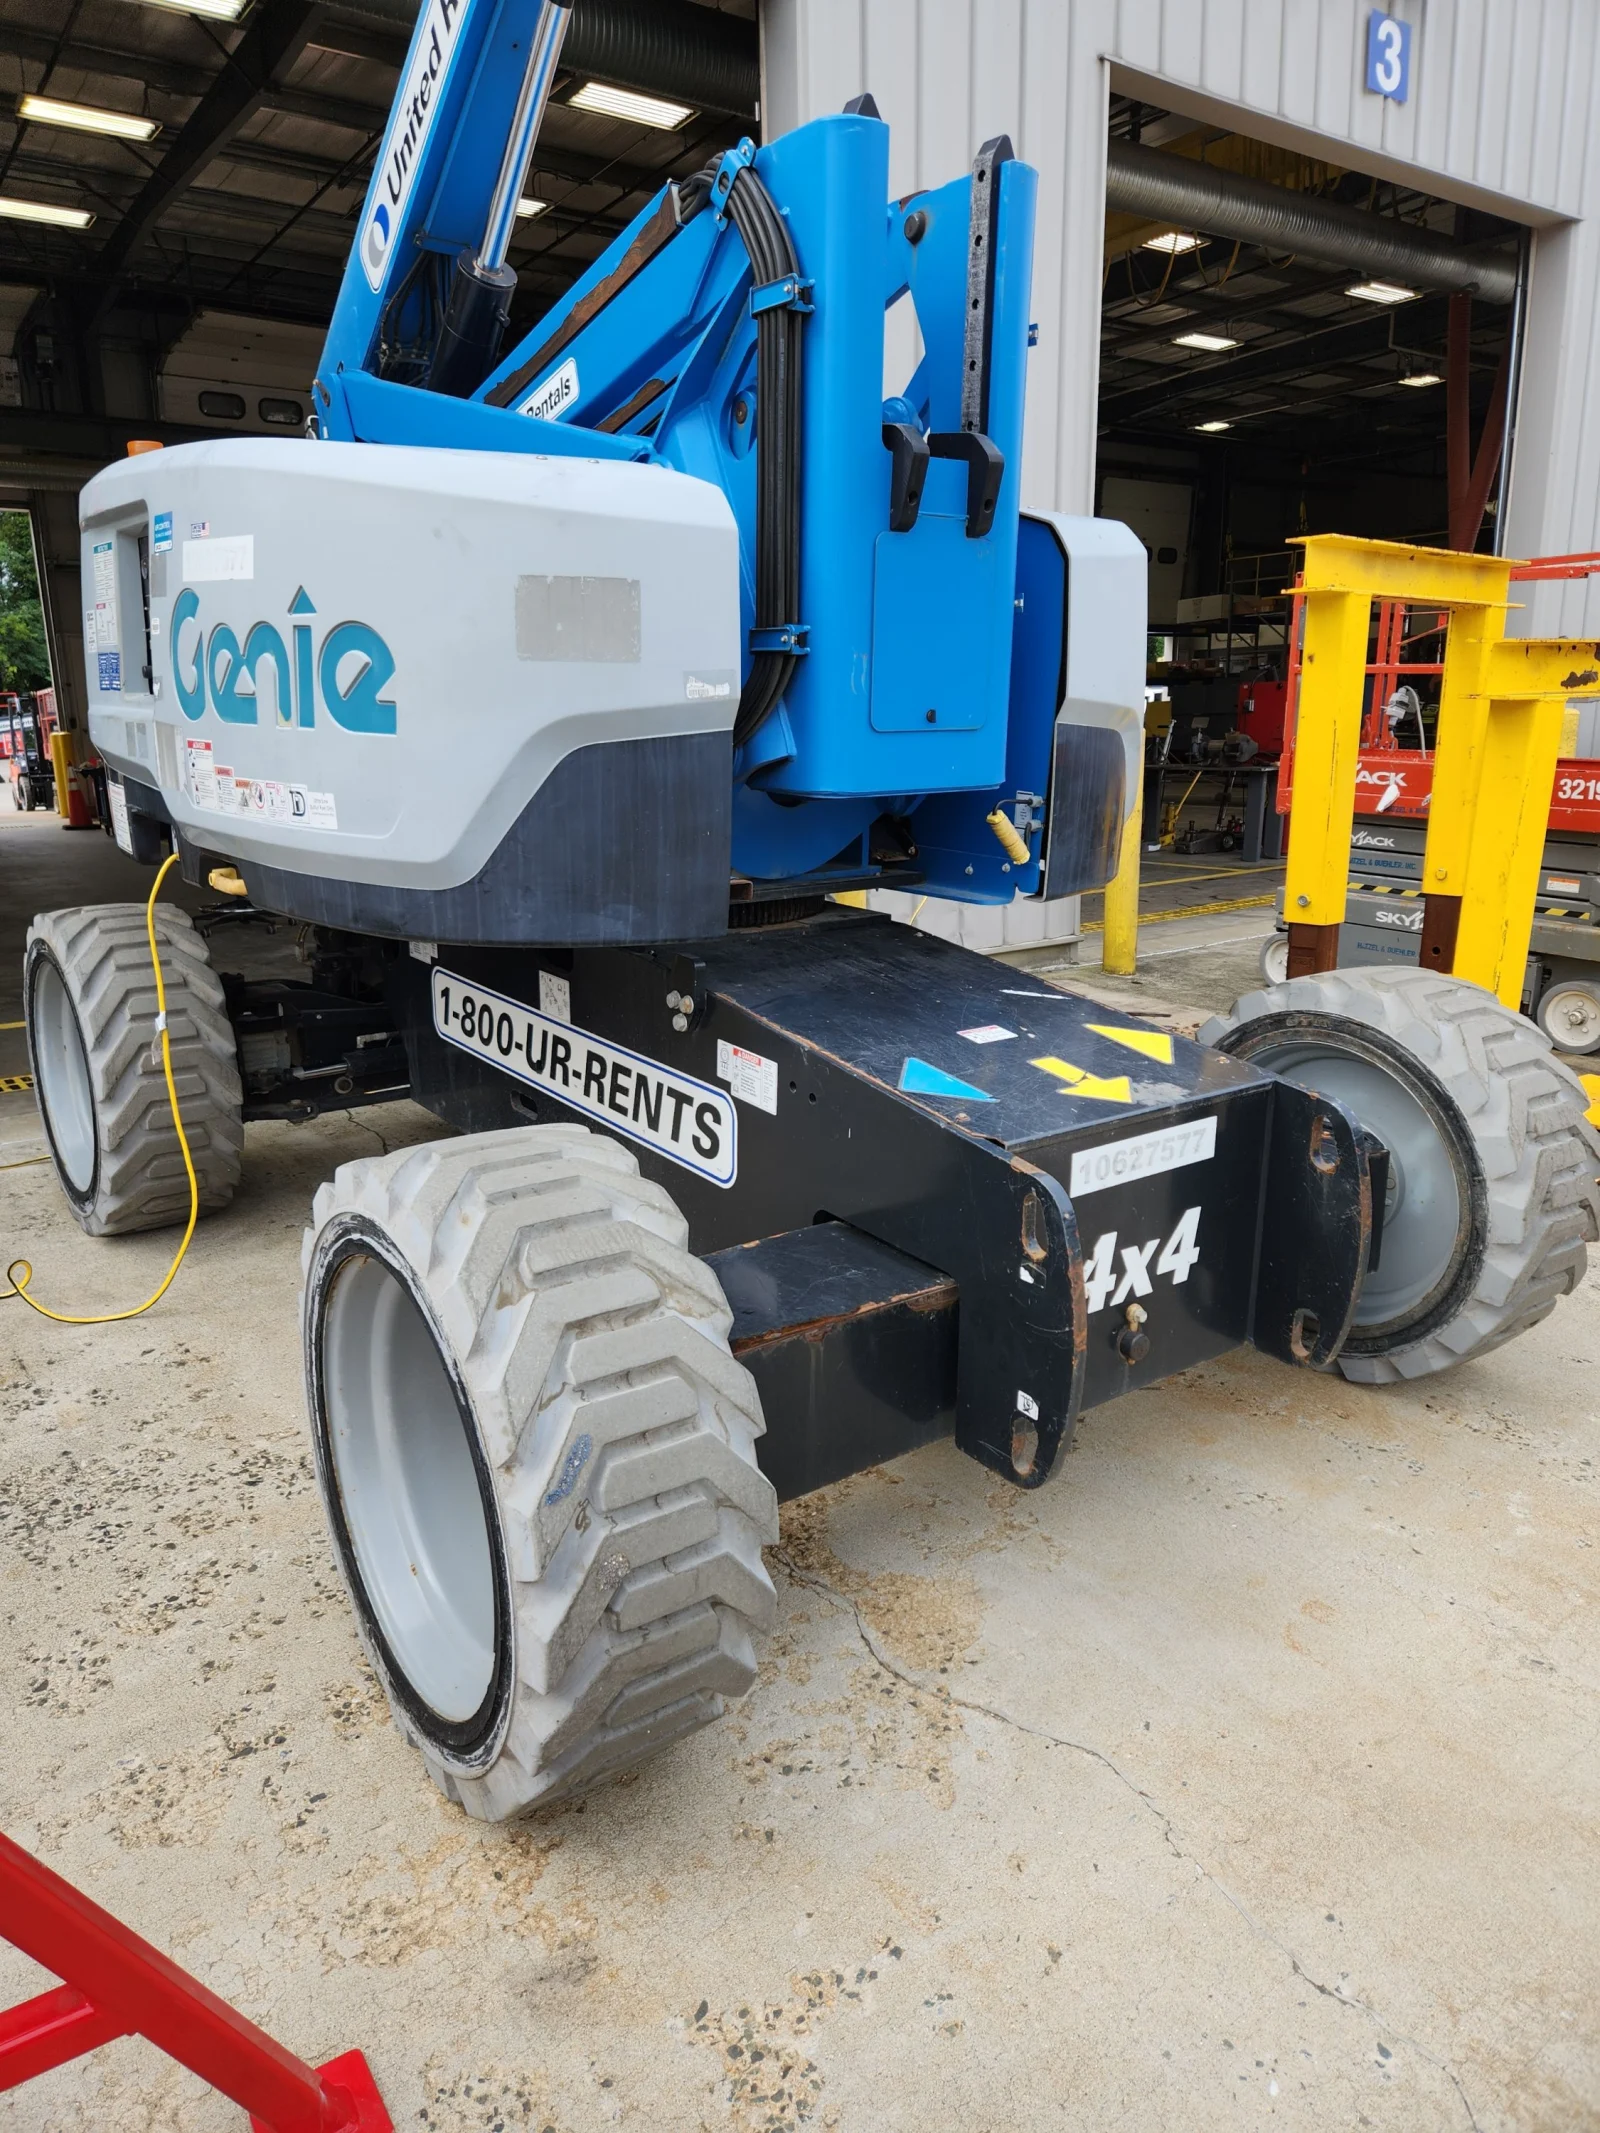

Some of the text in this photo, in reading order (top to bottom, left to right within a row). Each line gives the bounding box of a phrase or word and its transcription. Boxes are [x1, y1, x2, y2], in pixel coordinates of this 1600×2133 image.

[387, 22, 442, 206] United
[1376, 20, 1402, 92] 3
[170, 585, 397, 736] Genie
[1376, 910, 1424, 930] SKYJ
[440, 986, 722, 1160] 1-800-UR-RENTS
[1083, 1206, 1202, 1314] 4x4
